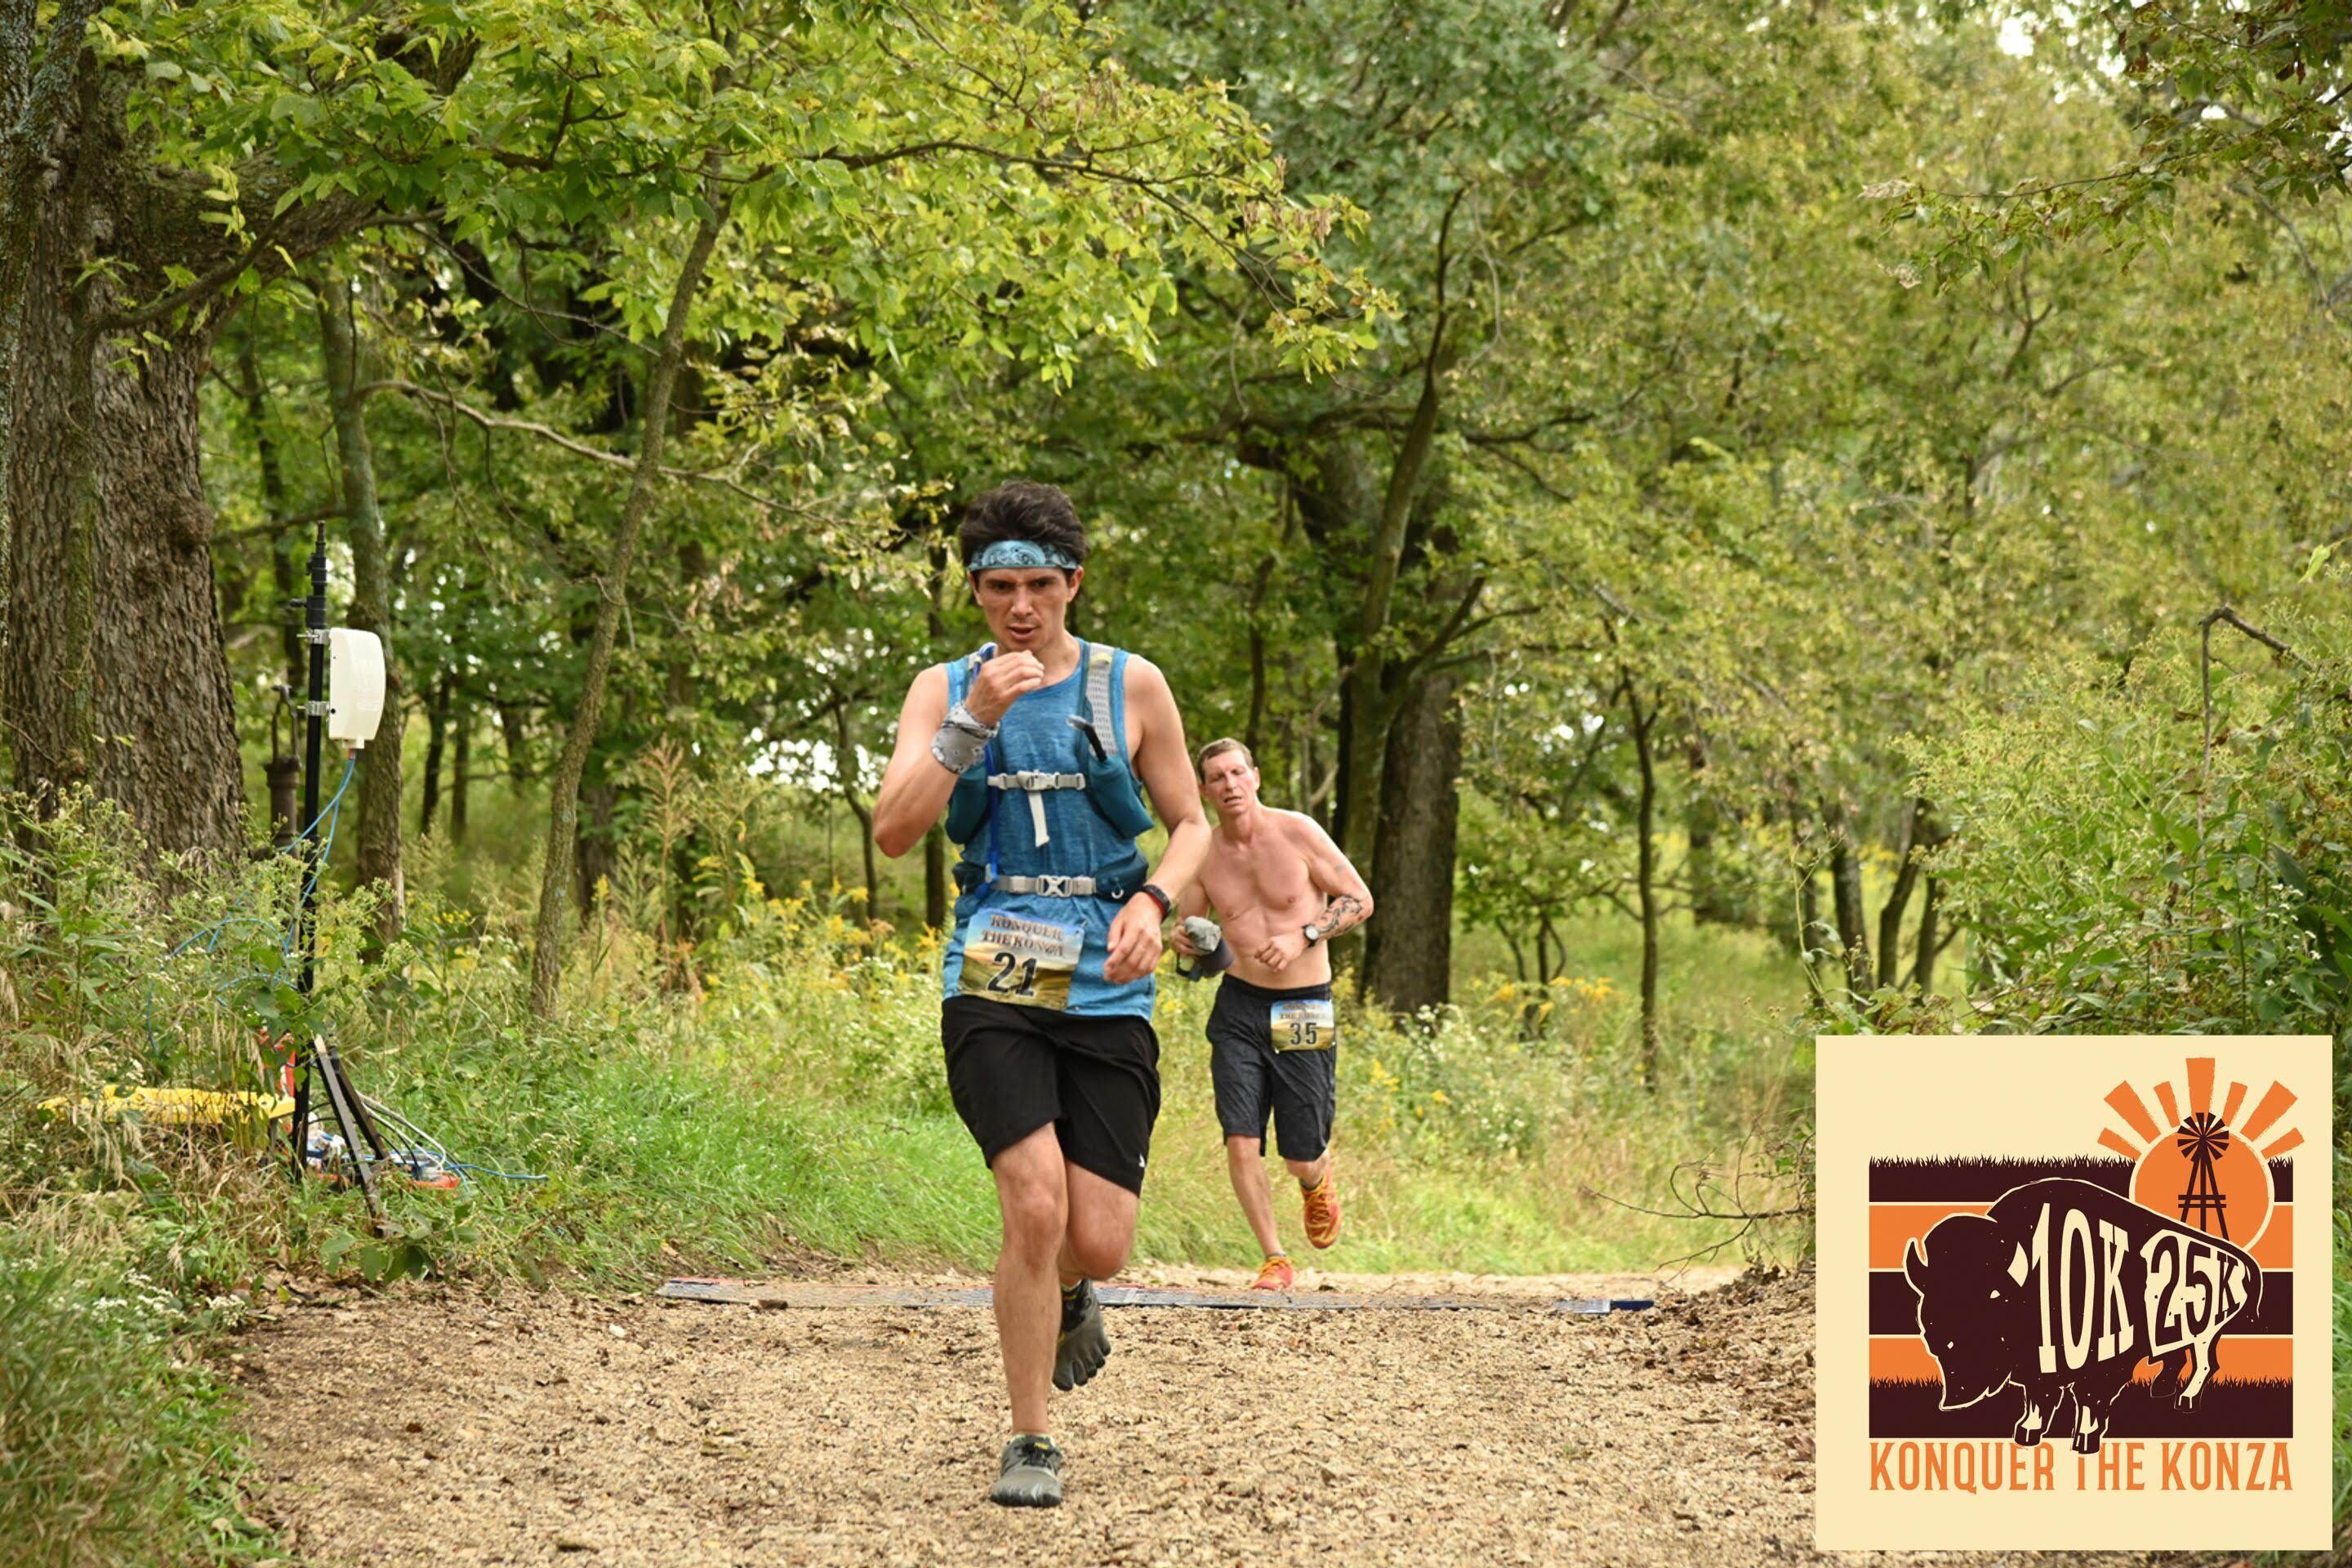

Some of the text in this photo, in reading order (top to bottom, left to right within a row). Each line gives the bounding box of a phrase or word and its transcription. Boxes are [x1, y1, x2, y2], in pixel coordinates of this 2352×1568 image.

[983, 930, 1010, 946] THE
[987, 952, 1037, 996] 21
[1290, 1022, 1317, 1045] 35
